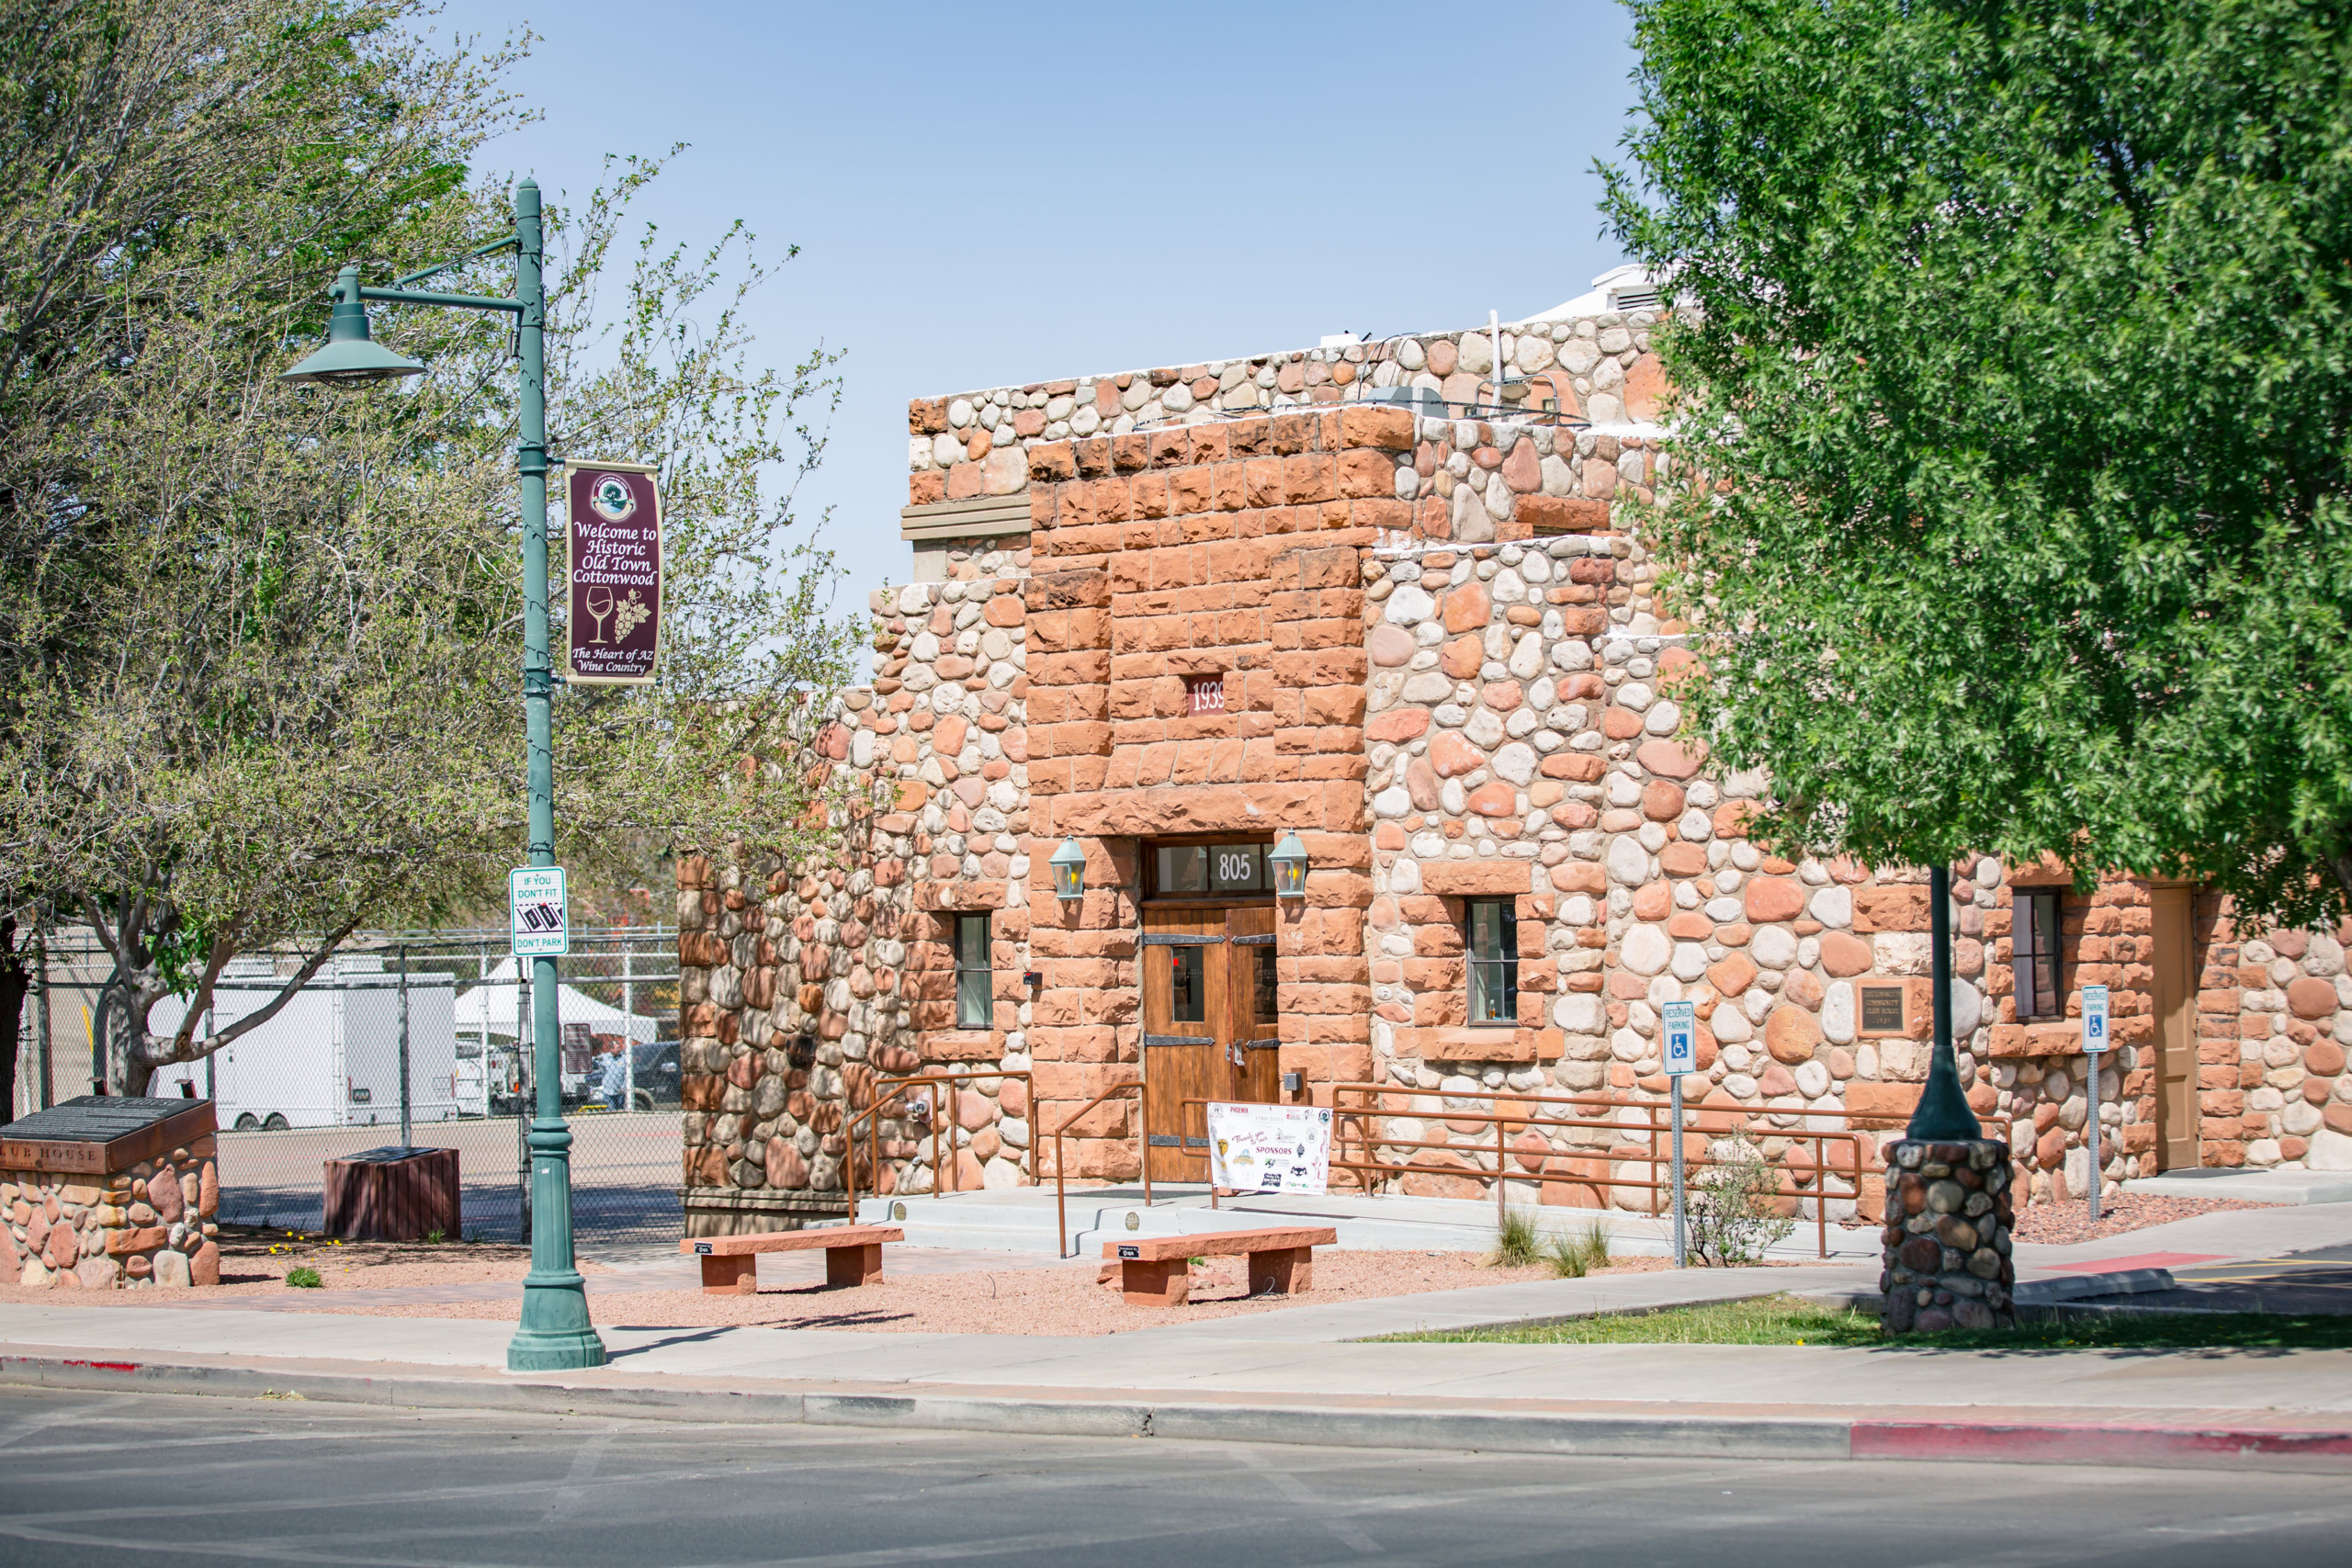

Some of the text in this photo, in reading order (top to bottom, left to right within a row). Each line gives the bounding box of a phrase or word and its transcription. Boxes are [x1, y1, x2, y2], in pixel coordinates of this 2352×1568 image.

[573, 521, 657, 541] Welcome to
[585, 538, 646, 556] Historic
[582, 554, 651, 571] Old Town
[573, 570, 658, 586] Cottonwood
[572, 647, 654, 663] The Heart of AZ
[577, 660, 647, 676] Wine Country
[1193, 681, 1225, 711] 1939
[1219, 853, 1250, 881] 805
[525, 876, 551, 886] IF YOU
[518, 888, 557, 898] DON'T FIT
[528, 913, 537, 926] LEGAL
[517, 938, 562, 948] DON'T PARK
[2084, 992, 2106, 1000] RESERVED
[1665, 1008, 1691, 1019] RESERVED
[1668, 1021, 1690, 1031] PARKING
[1231, 1131, 1264, 1143] Thank you
[40, 1147, 96, 1161] HOUSE
[1256, 1145, 1292, 1155] SPONSORS
